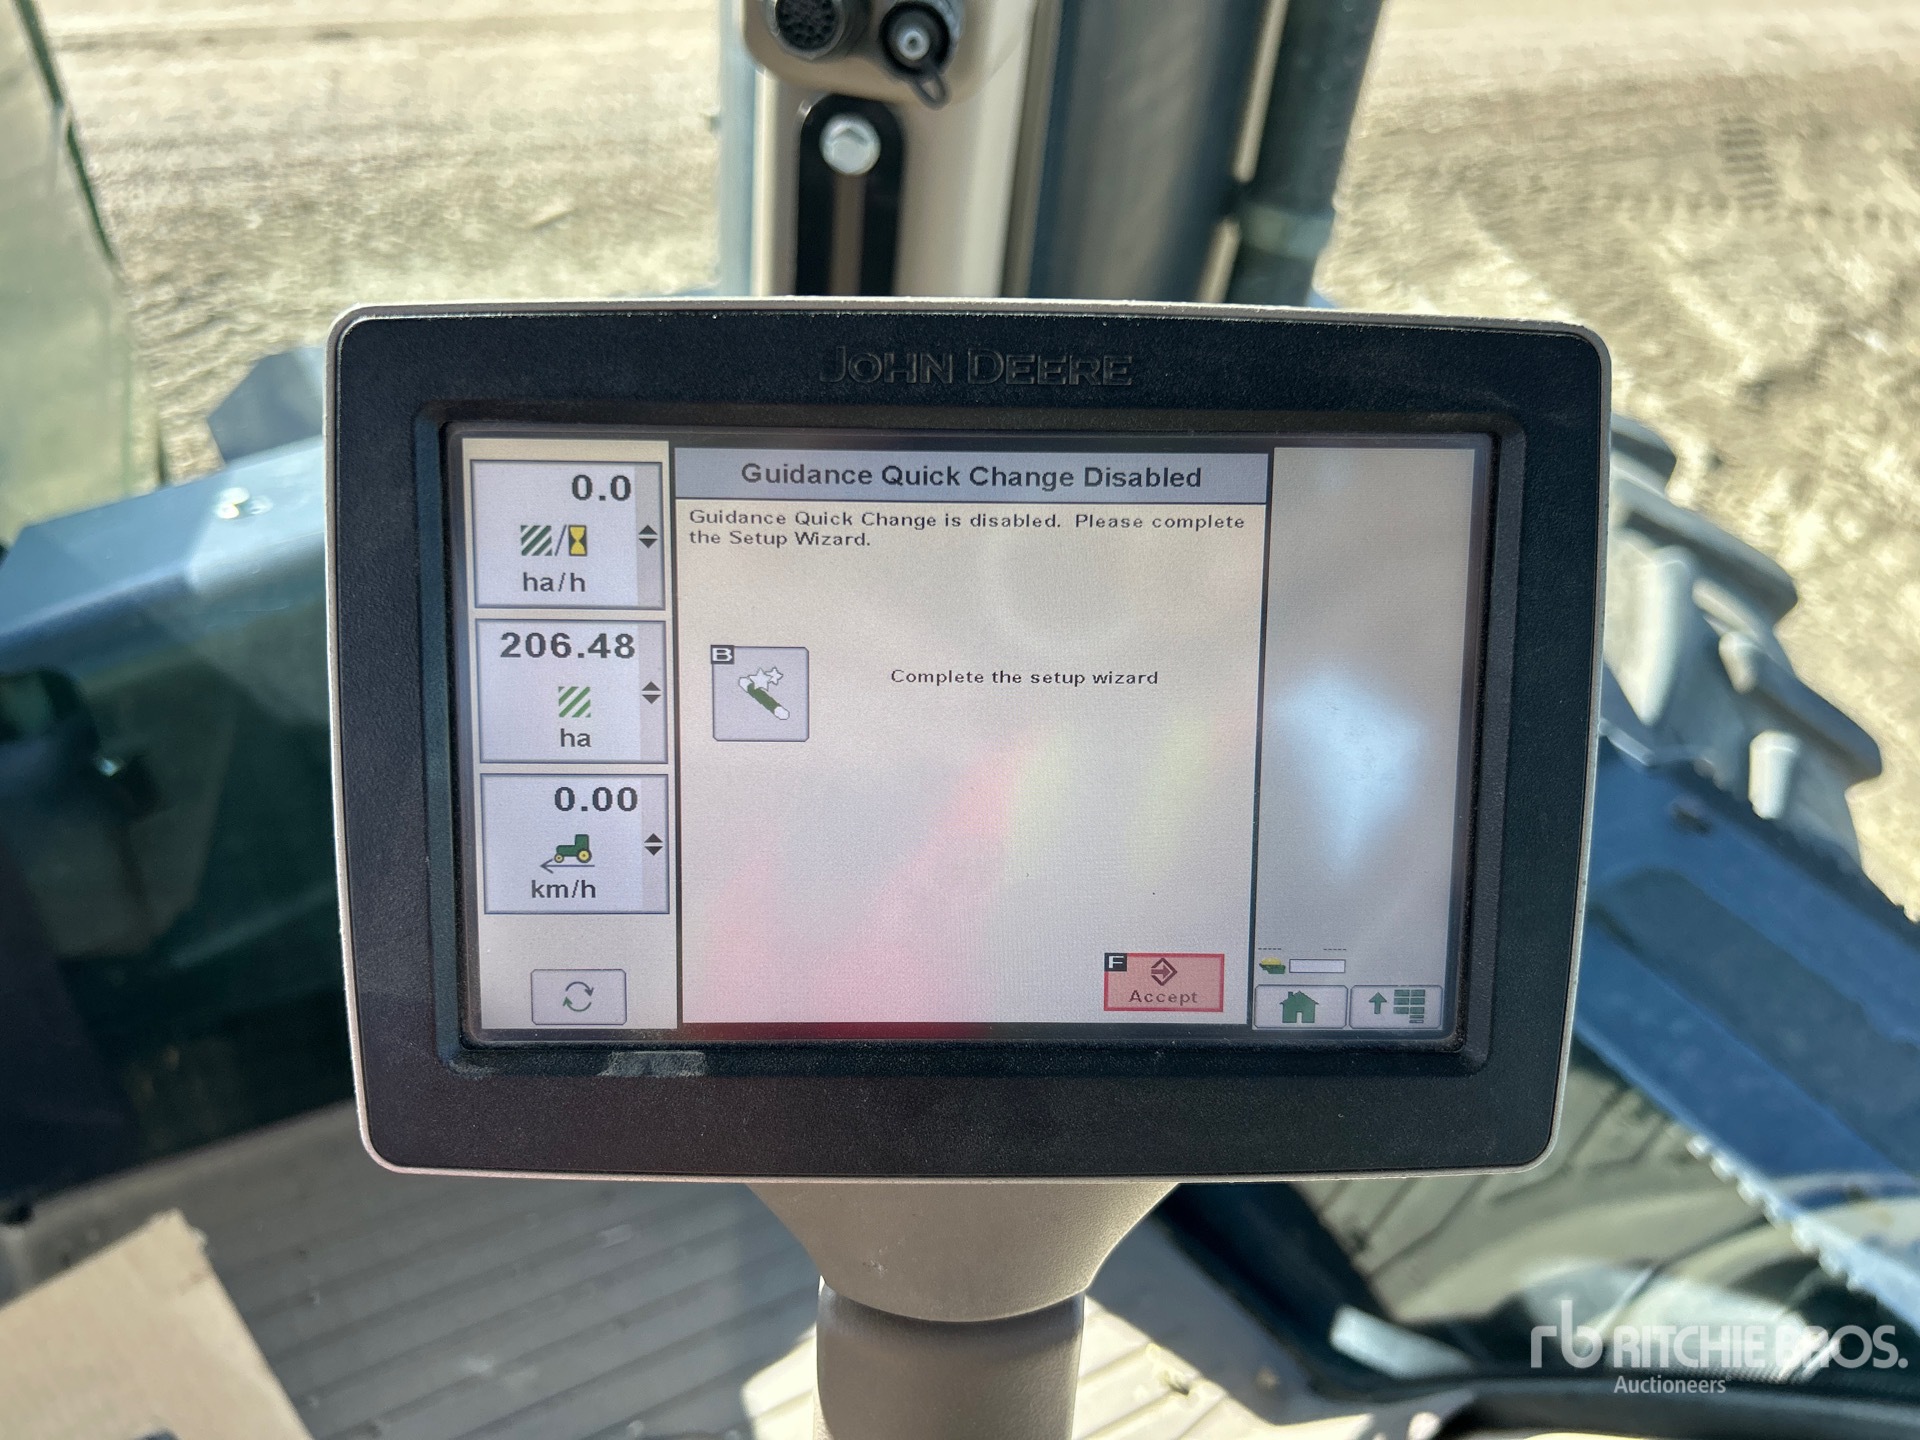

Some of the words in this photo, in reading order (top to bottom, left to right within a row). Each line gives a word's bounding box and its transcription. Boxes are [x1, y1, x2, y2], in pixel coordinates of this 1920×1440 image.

[819, 345, 953, 384] JOHN
[966, 348, 1133, 386] DEERE
[571, 474, 633, 502] 0.0
[741, 463, 873, 486] Guidance
[881, 465, 960, 488] Quick
[969, 466, 1075, 491] Change
[1083, 467, 1202, 490] Disabled
[689, 509, 787, 526] Guidance
[795, 511, 853, 527] Quick
[861, 512, 937, 530] Change
[944, 513, 961, 528] is
[970, 513, 1062, 530] disabled.
[1075, 514, 1144, 530] Please
[1151, 514, 1246, 533] complete
[689, 530, 722, 546] the
[729, 531, 788, 549] Setup
[795, 532, 872, 548] Wizard.
[522, 572, 586, 594] ha/h
[499, 631, 636, 660] 206.48
[713, 648, 733, 661] B
[892, 669, 984, 687] Complete
[992, 670, 1023, 685] the
[1029, 670, 1086, 688] setup
[1092, 670, 1159, 686] wizard
[560, 727, 592, 749] ha
[554, 786, 638, 812] 0.00
[531, 879, 596, 899] km/h
[1108, 956, 1124, 969] F
[1128, 990, 1197, 1006] Accept
